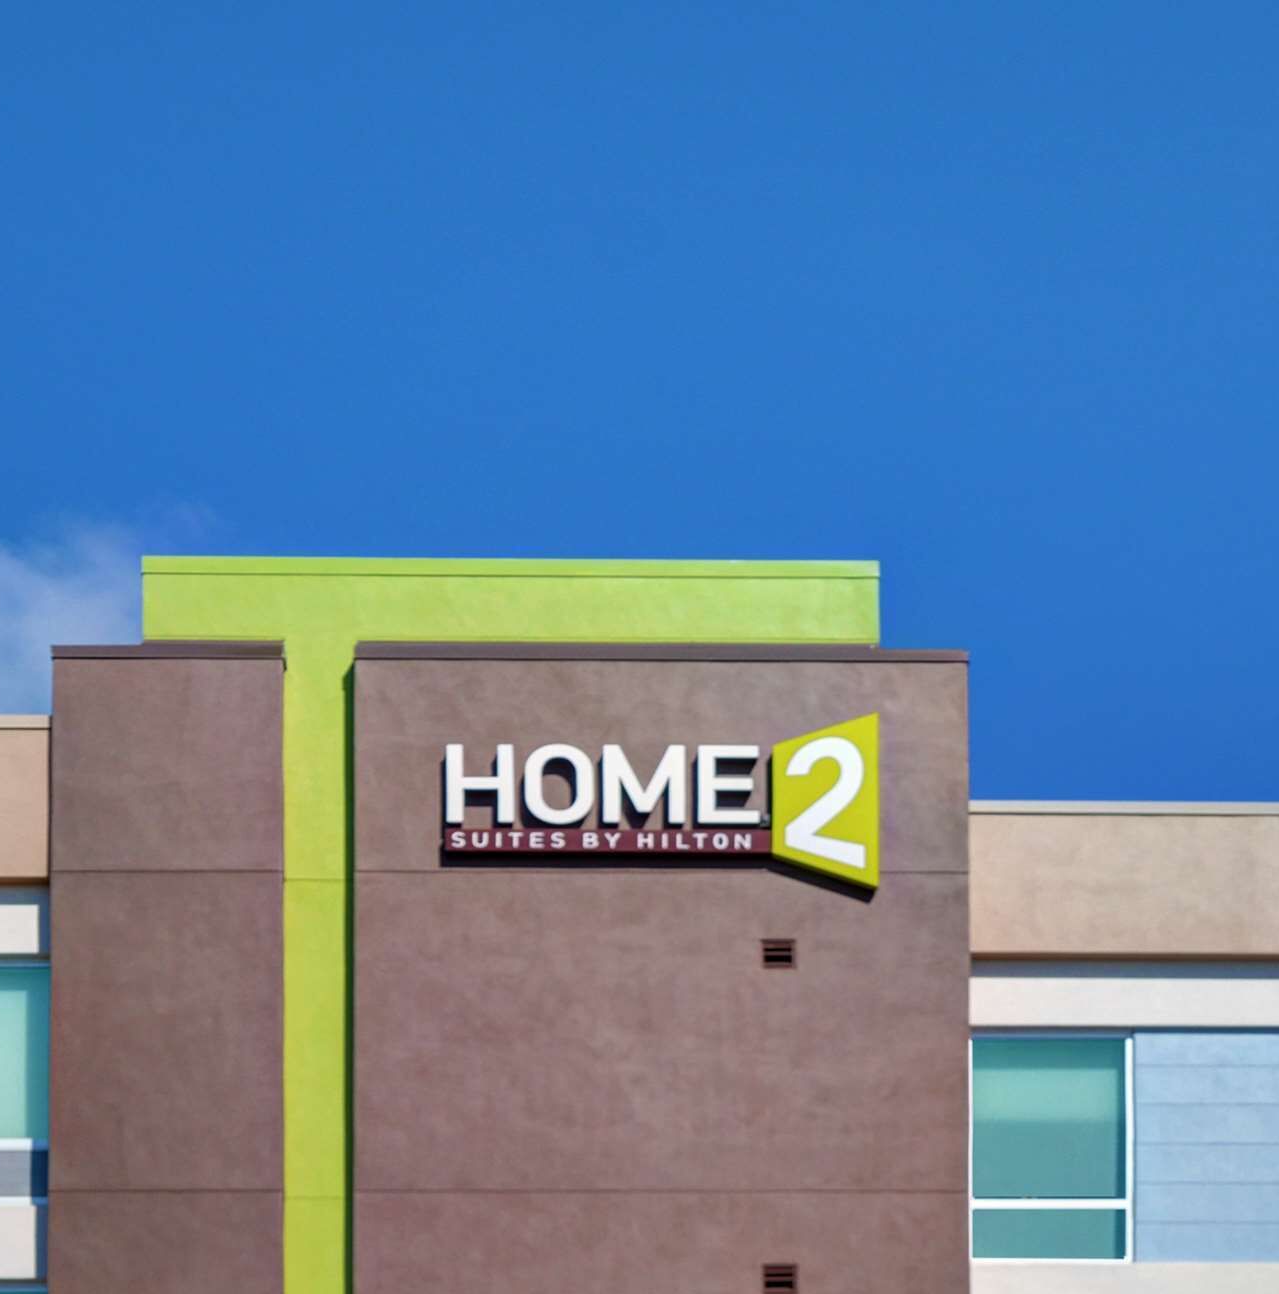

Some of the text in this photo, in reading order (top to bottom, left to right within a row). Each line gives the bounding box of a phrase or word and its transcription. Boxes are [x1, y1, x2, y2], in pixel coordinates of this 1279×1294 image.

[445, 736, 866, 870] HOME 2
[450, 831, 753, 850] SUITES BY HILTON
